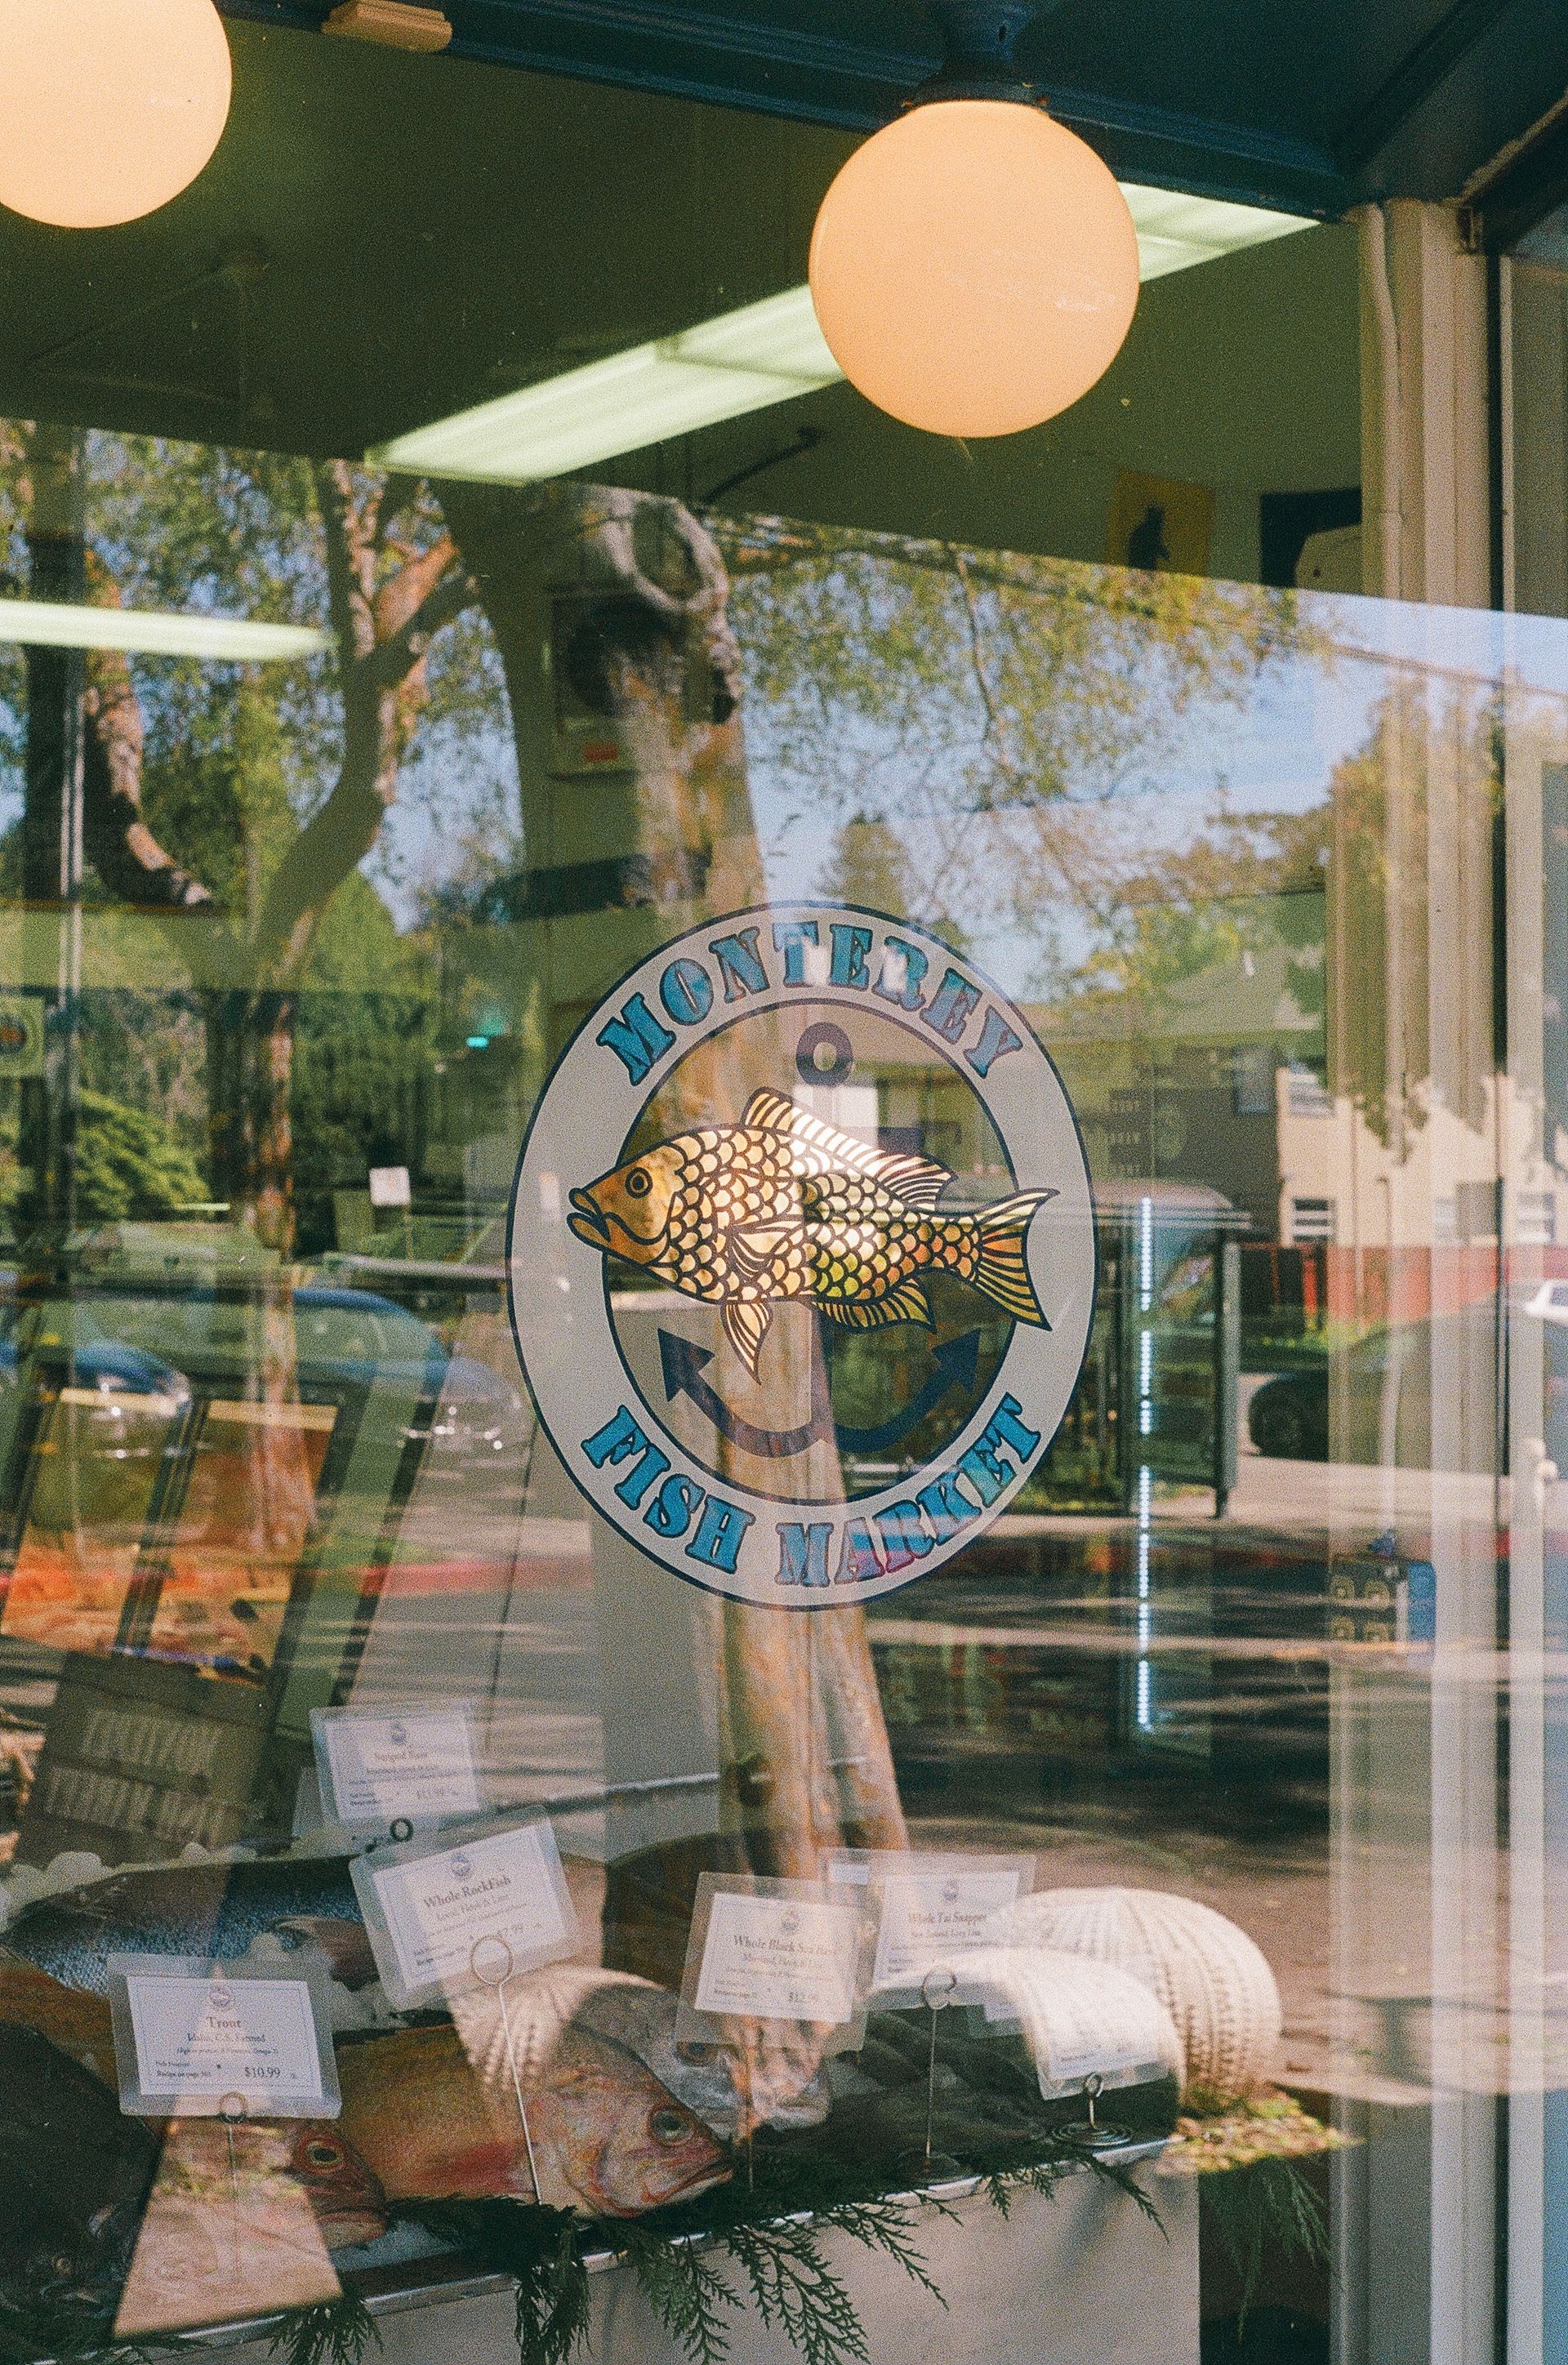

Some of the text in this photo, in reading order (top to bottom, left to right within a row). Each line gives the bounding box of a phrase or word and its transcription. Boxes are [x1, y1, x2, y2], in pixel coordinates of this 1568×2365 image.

[597, 921, 1024, 1086] MONTEREY
[581, 1393, 1042, 1589] FISH MARKET
[423, 1891, 460, 1908] Whole
[733, 1935, 765, 1949] Whole
[206, 2015, 243, 2029] Trout
[244, 2066, 281, 2078] $10.99
